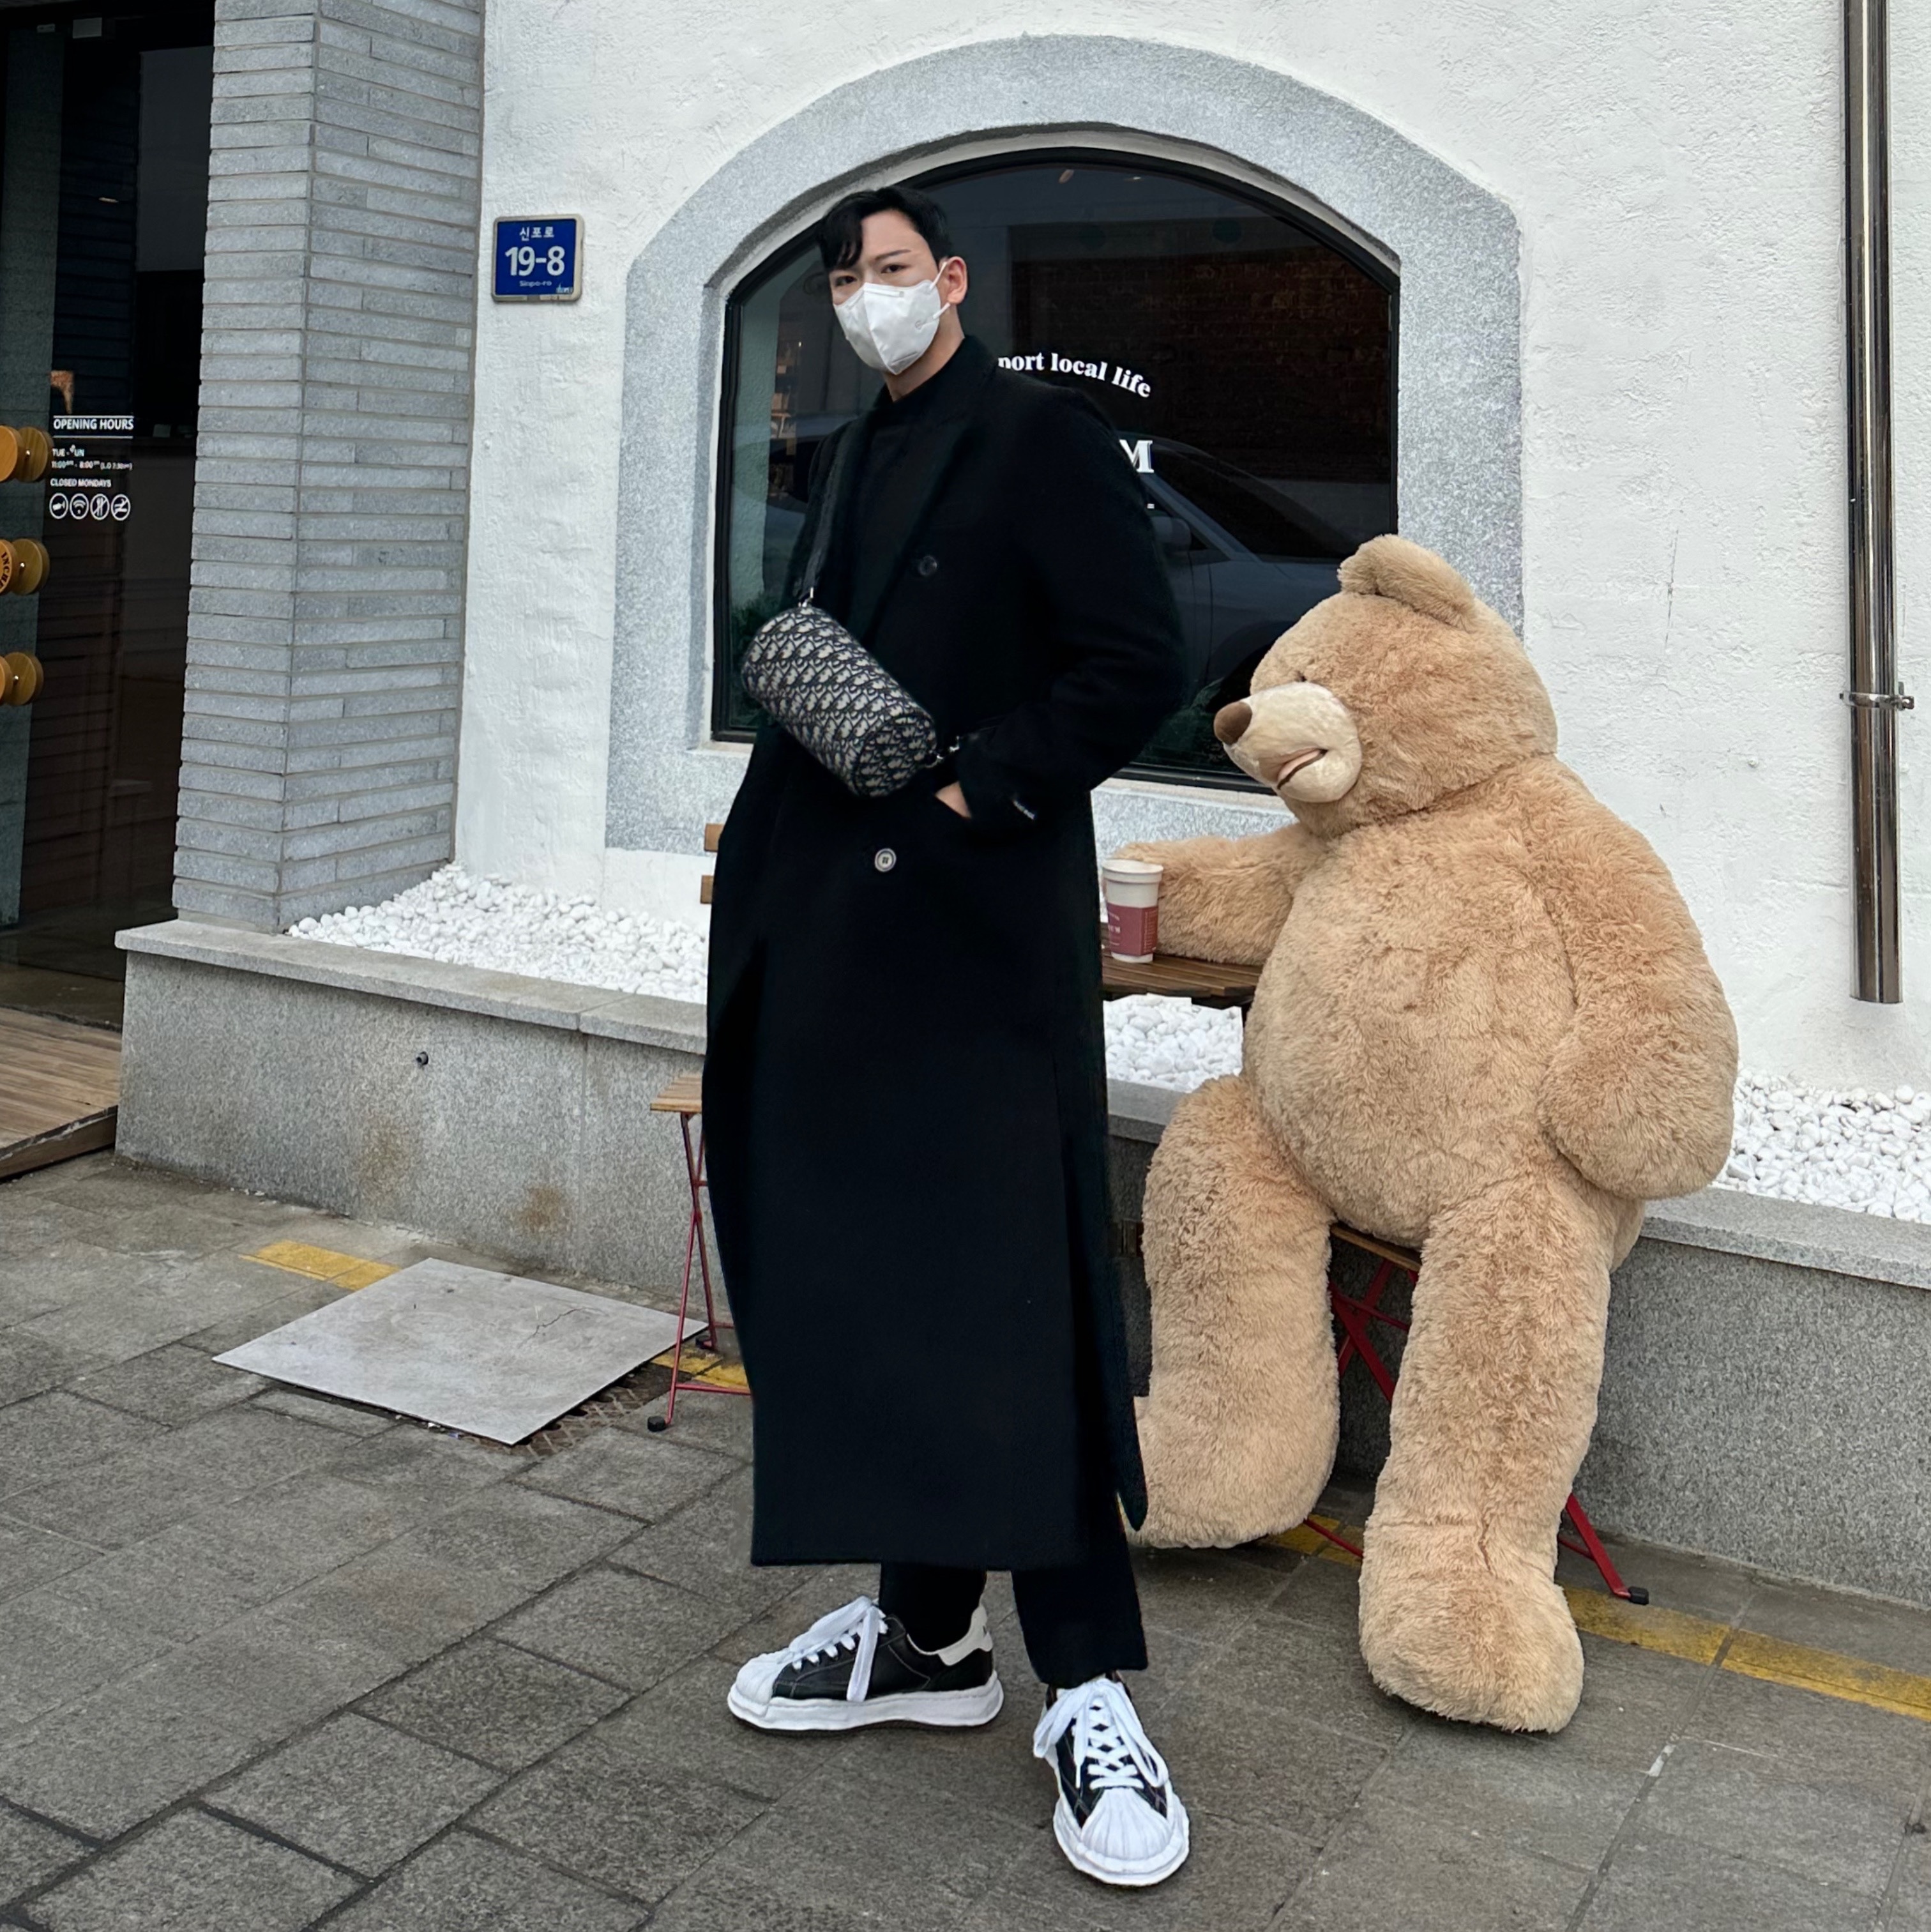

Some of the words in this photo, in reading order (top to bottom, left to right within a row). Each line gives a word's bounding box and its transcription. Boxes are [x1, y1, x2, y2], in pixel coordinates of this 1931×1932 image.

[519, 226, 554, 241] 신포로
[504, 245, 565, 277] 19-8
[1050, 353, 1108, 381] local
[1111, 366, 1151, 398] life
[53, 418, 97, 430] OPENING
[99, 418, 134, 430] HOURS
[52, 448, 66, 457] TUE
[50, 478, 77, 487] CLOSED
[77, 478, 112, 488] MONDAYS
